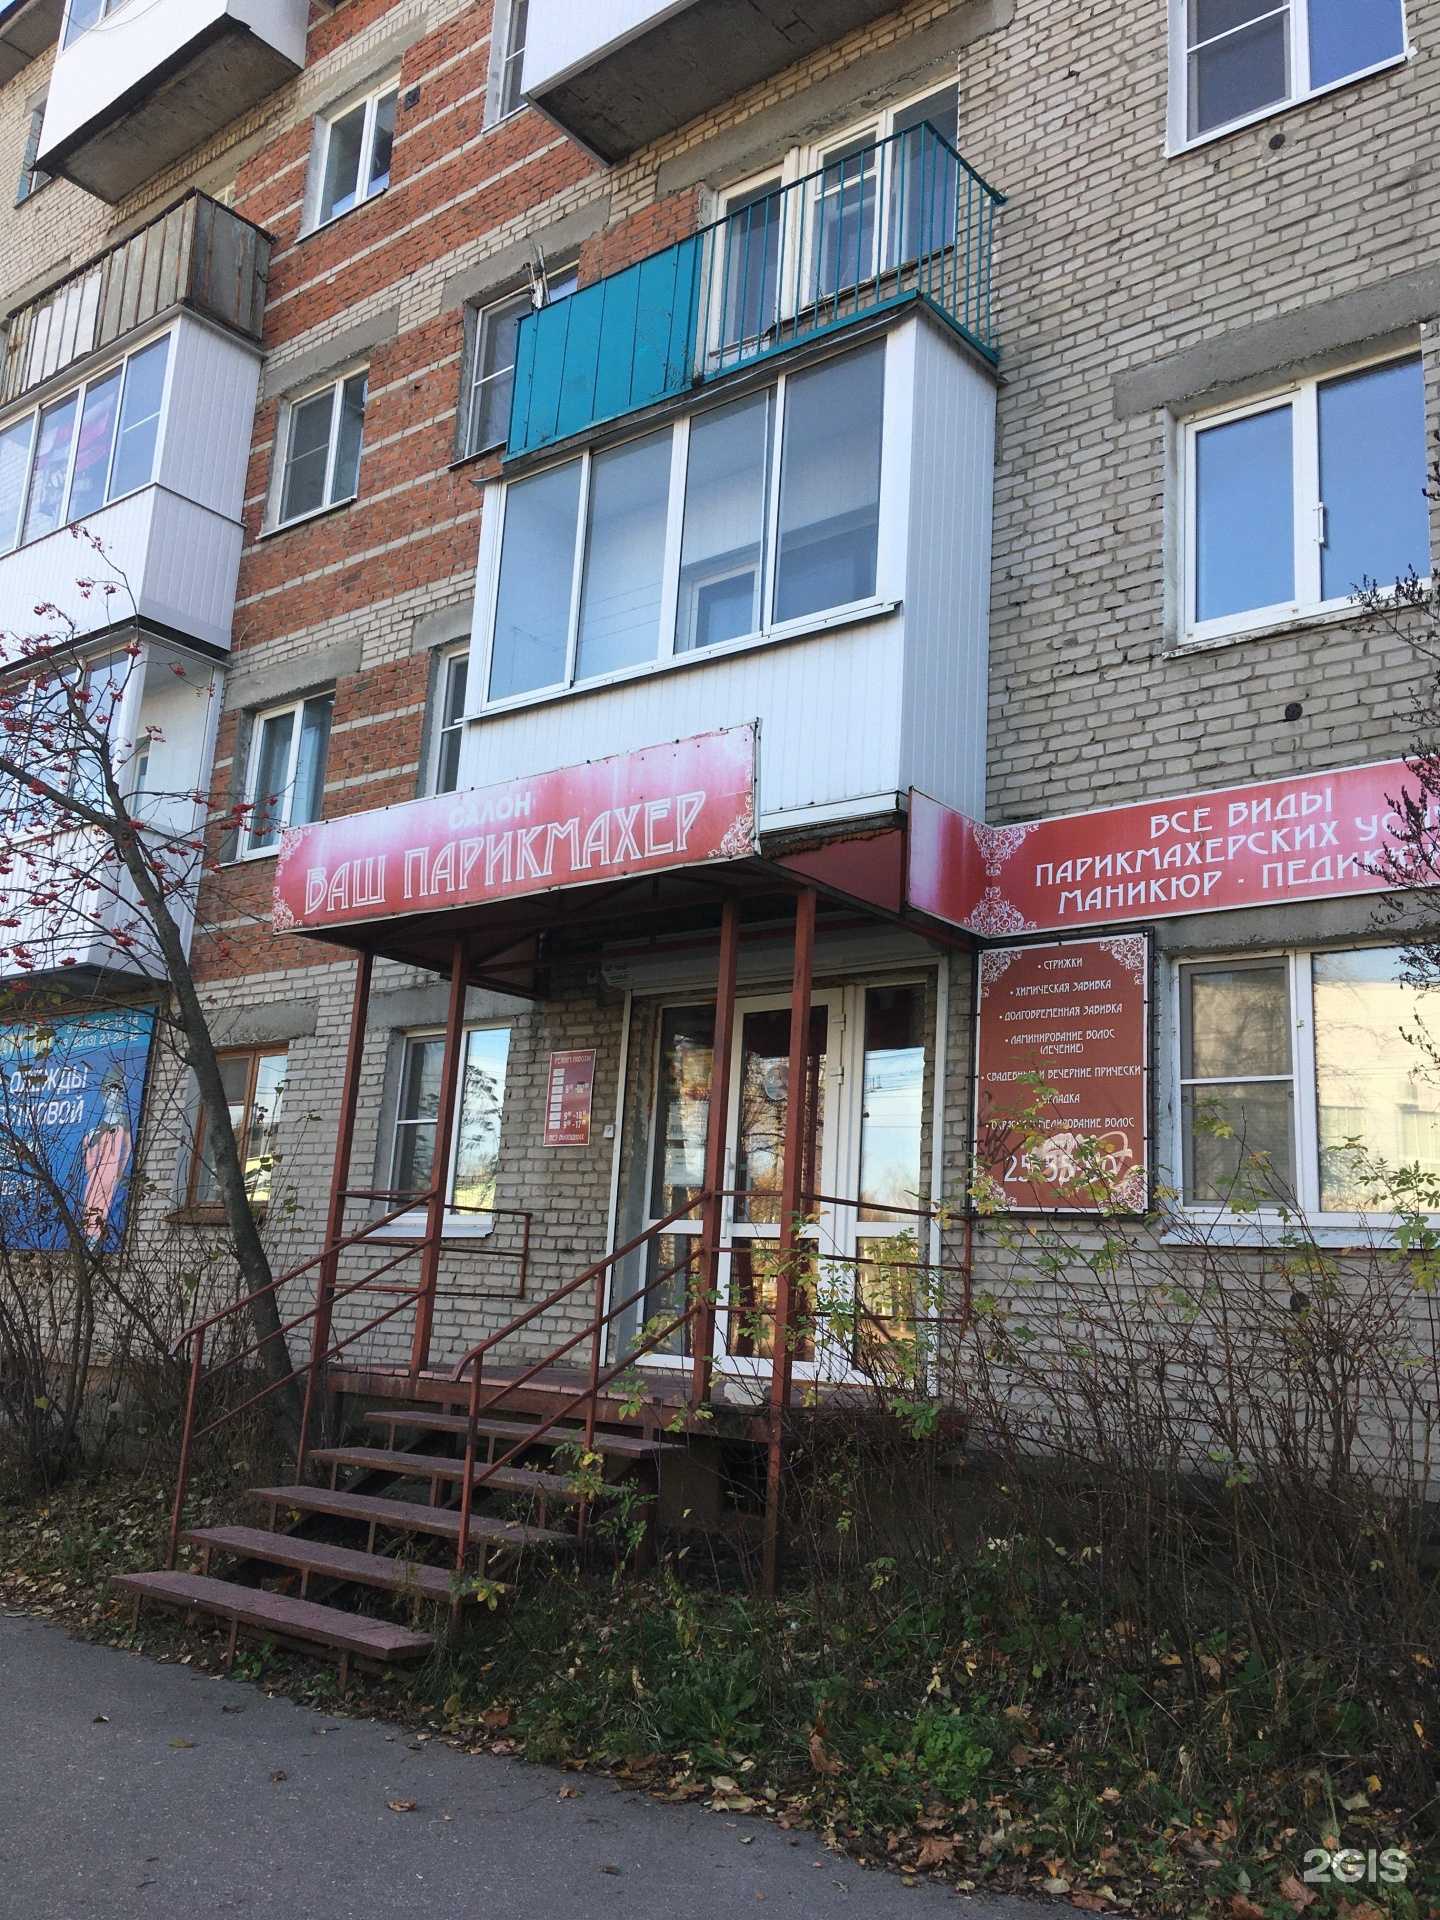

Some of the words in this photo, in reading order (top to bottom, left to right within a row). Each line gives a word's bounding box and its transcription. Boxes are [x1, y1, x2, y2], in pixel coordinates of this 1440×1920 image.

[449, 791, 532, 830] САЛОН
[1150, 807, 1213, 840] ВСЕ
[1228, 787, 1333, 826] ВИДЫ
[304, 854, 387, 917] ВАШ
[404, 790, 706, 900] ПАРИКМАХЕР
[1034, 820, 1340, 888] ПАРИКМАХЕРСКИХ
[1058, 870, 1223, 915] МАНИКЮР
[1043, 957, 1083, 971] СТРИЖКИ
[1015, 982, 1070, 997] ХИМИЧЕСКАЯ
[1073, 979, 1112, 993] ЗАВИВКА
[1004, 1006, 1081, 1022] ДОЛГОВРЕМЕННАЯ
[1083, 1003, 1123, 1016] ЗАВИВКА
[1010, 1030, 1083, 1045] ЛАМИНИРОВАНИЕ
[1086, 1028, 1116, 1041] ВОЛОС
[1040, 1043, 1084, 1056] (ЛЕЧЕНИЕ)
[1048, 1067, 1092, 1079] ВЕЧЕРНИЕ
[1095, 1065, 1141, 1077] ПРИЧЕСКИ
[1105, 1116, 1135, 1128] ВОЛОС
